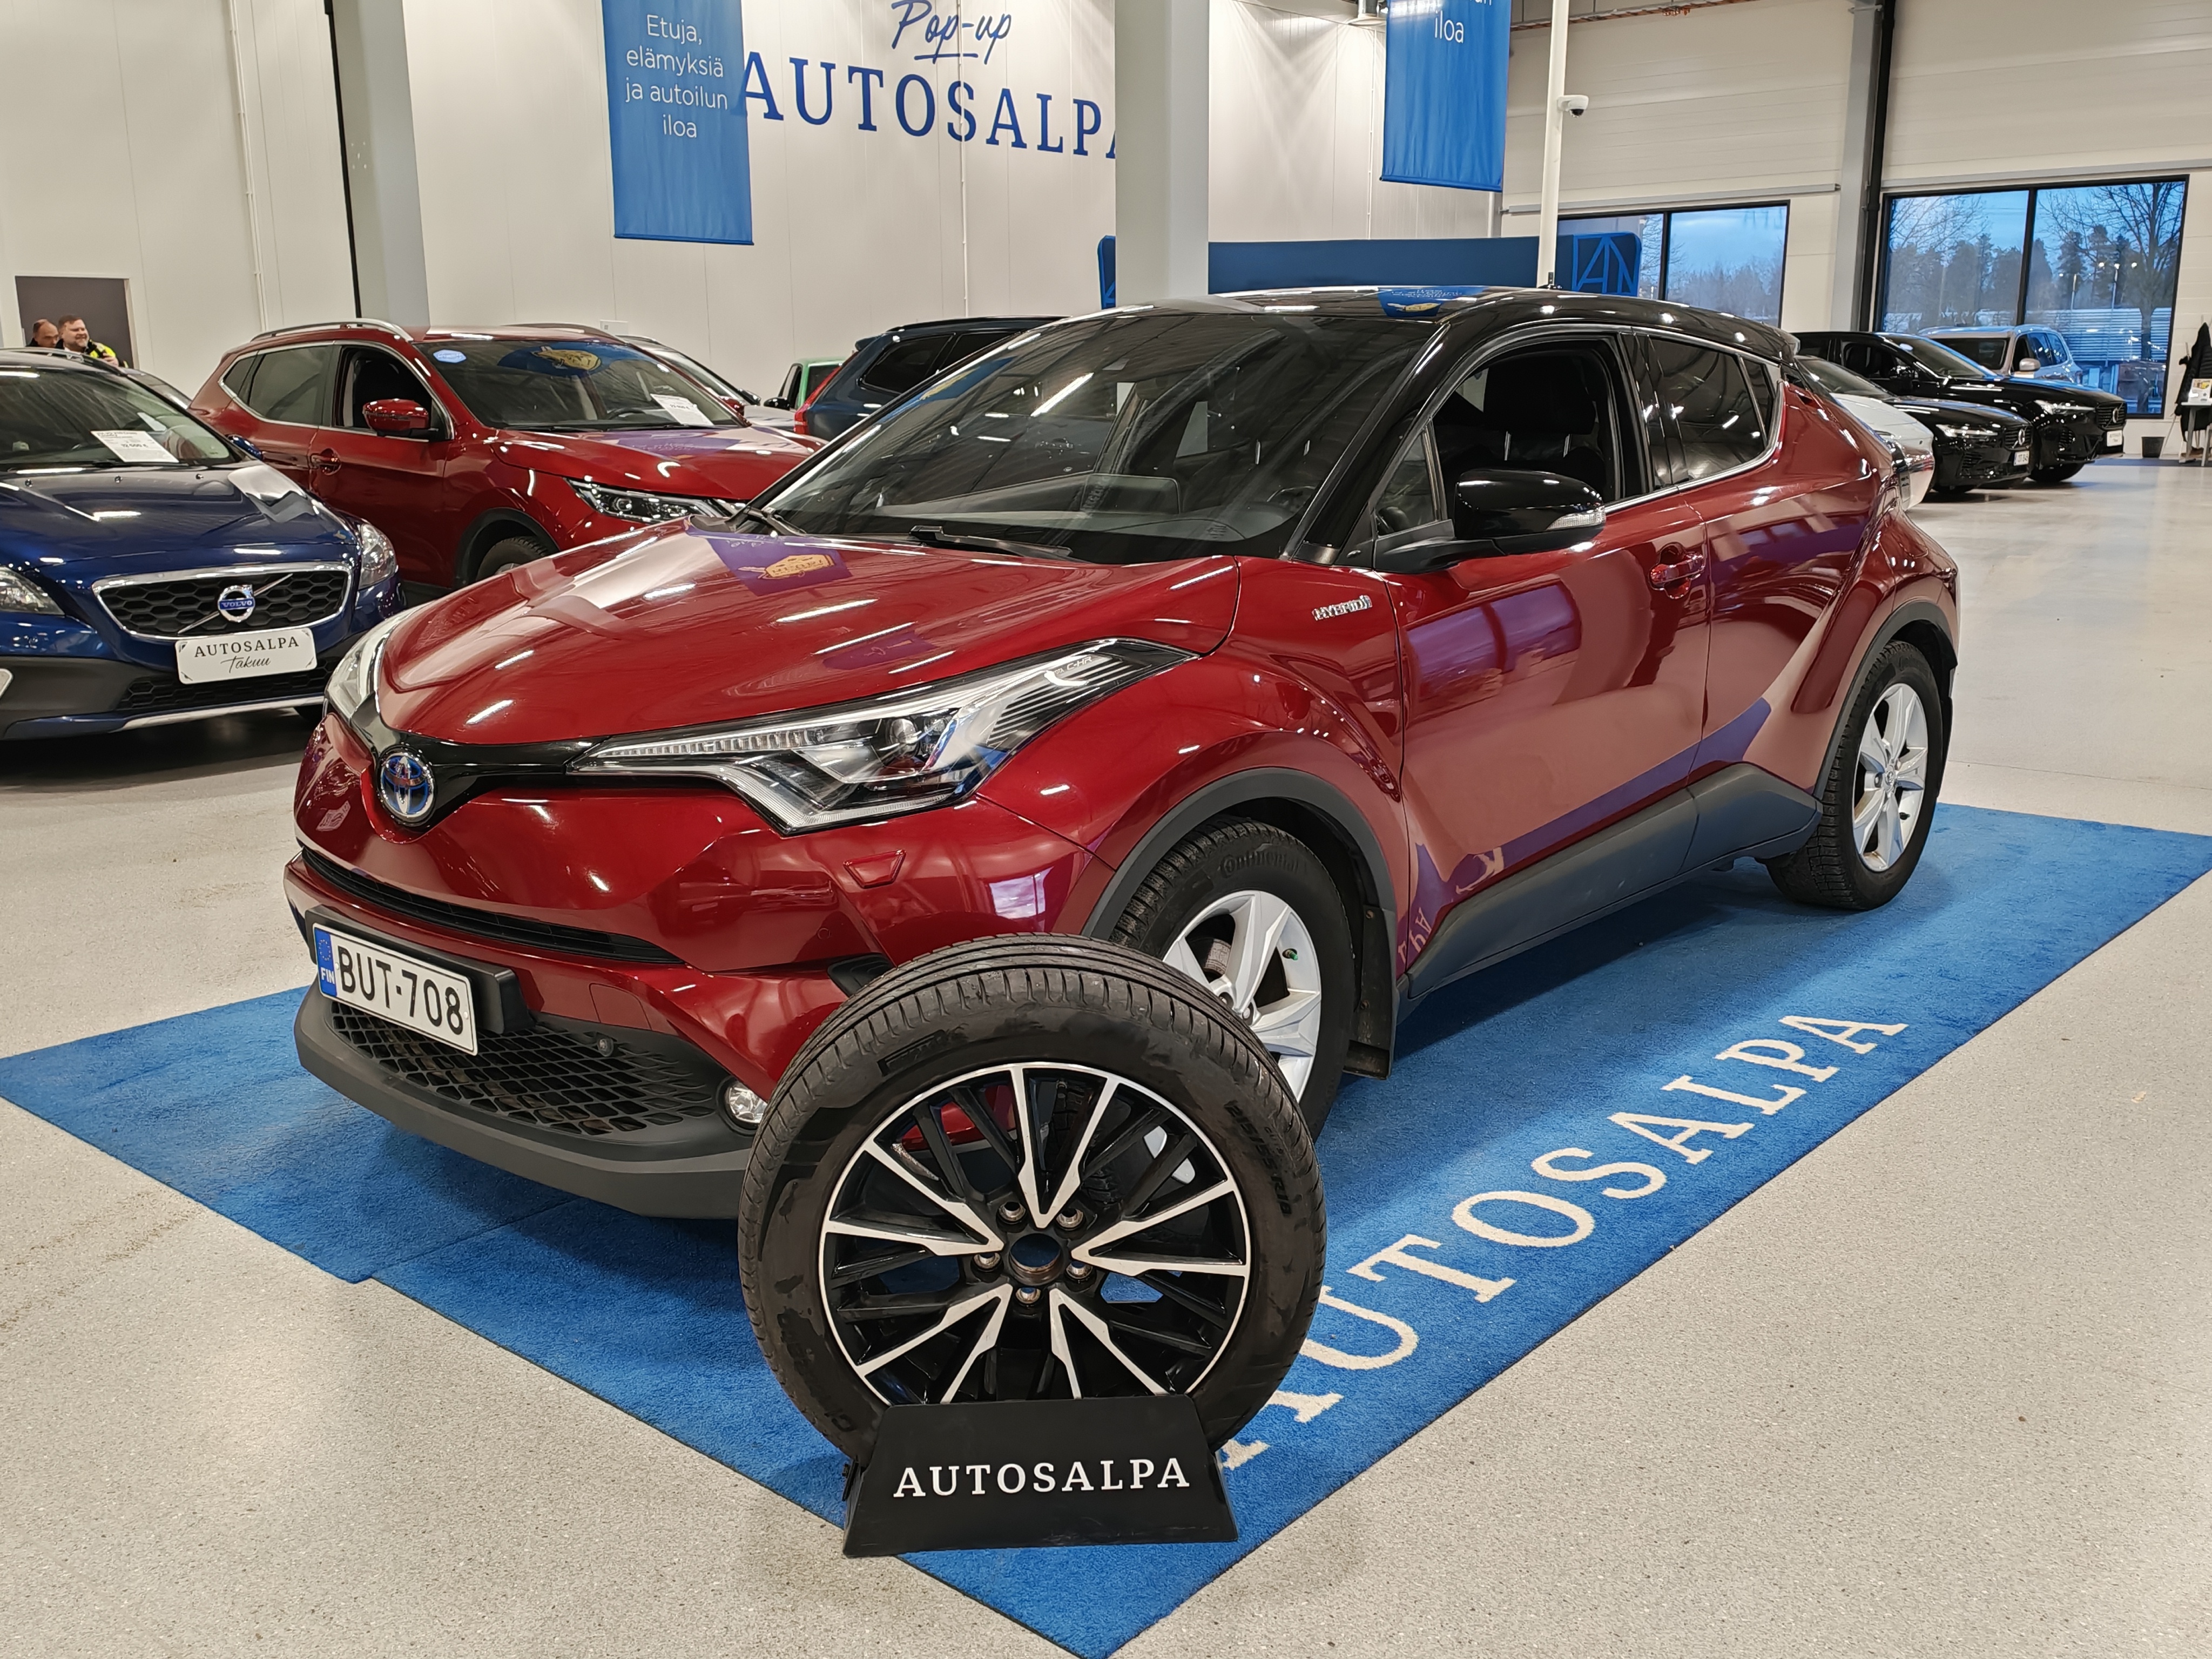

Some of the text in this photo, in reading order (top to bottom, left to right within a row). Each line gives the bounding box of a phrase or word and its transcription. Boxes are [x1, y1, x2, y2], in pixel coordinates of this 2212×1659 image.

[647, 14, 702, 45] Etuja,
[891, 0, 1011, 64] Pop-up
[1434, 10, 1464, 43] iloa
[626, 45, 724, 78] elämyksiä
[625, 77, 727, 110] ja autoilun
[731, 51, 1115, 159] AUTOSALP
[663, 114, 697, 138] iloa
[221, 600, 252, 608] VOLVO
[1312, 596, 1367, 621] HYBRID
[194, 636, 299, 657] AUTOSALPA
[220, 655, 272, 674] Takuu
[1067, 656, 1092, 670] C-HR
[320, 967, 335, 984] FIN
[337, 945, 464, 1036] BUT-708
[893, 1457, 1190, 1498] AUTOSALPA
